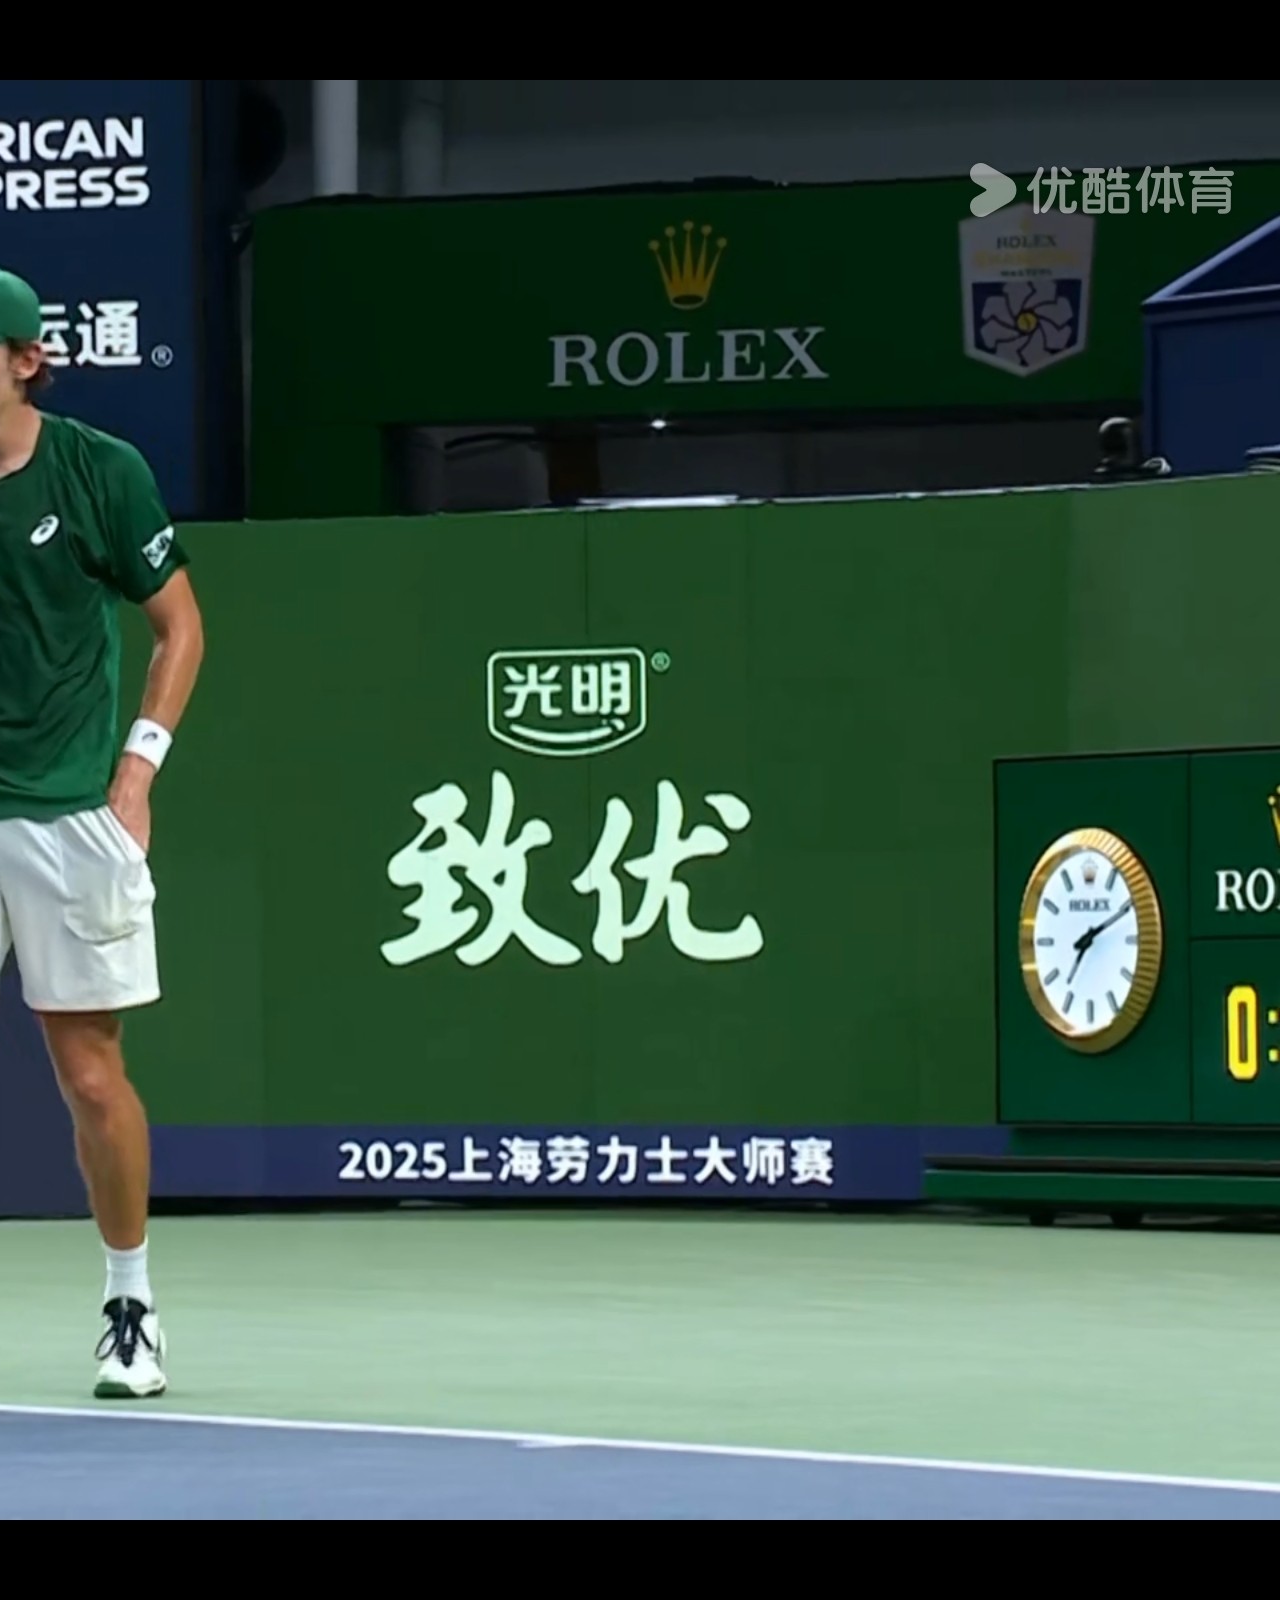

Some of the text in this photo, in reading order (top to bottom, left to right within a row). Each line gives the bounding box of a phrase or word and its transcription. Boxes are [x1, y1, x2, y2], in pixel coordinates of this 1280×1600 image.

[549, 326, 829, 388] ROLEX
[503, 661, 631, 718] 光明
[380, 769, 764, 966] 致优
[1215, 867, 1280, 913] RO
[1069, 898, 1111, 912] ROLEX
[338, 1135, 834, 1186] 2025上海劳力士大师赛
